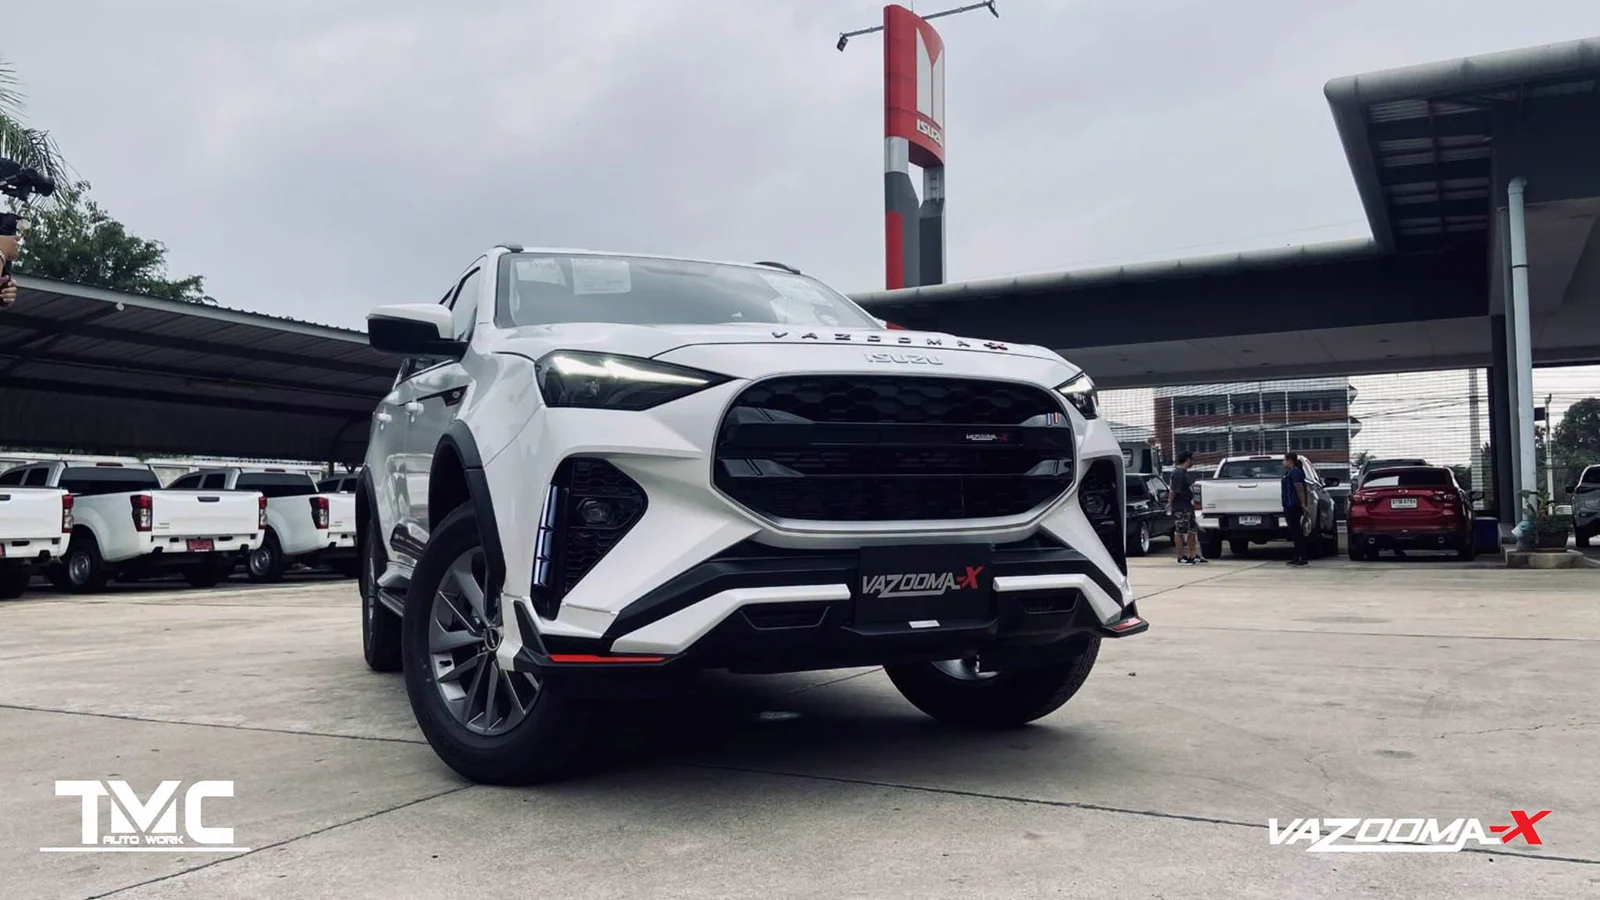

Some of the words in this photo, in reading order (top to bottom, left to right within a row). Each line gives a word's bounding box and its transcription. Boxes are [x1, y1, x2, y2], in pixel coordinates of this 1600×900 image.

[916, 118, 943, 147] ISUZ
[864, 353, 944, 365] ISUZU
[862, 565, 984, 598] VAZOOMA-X
